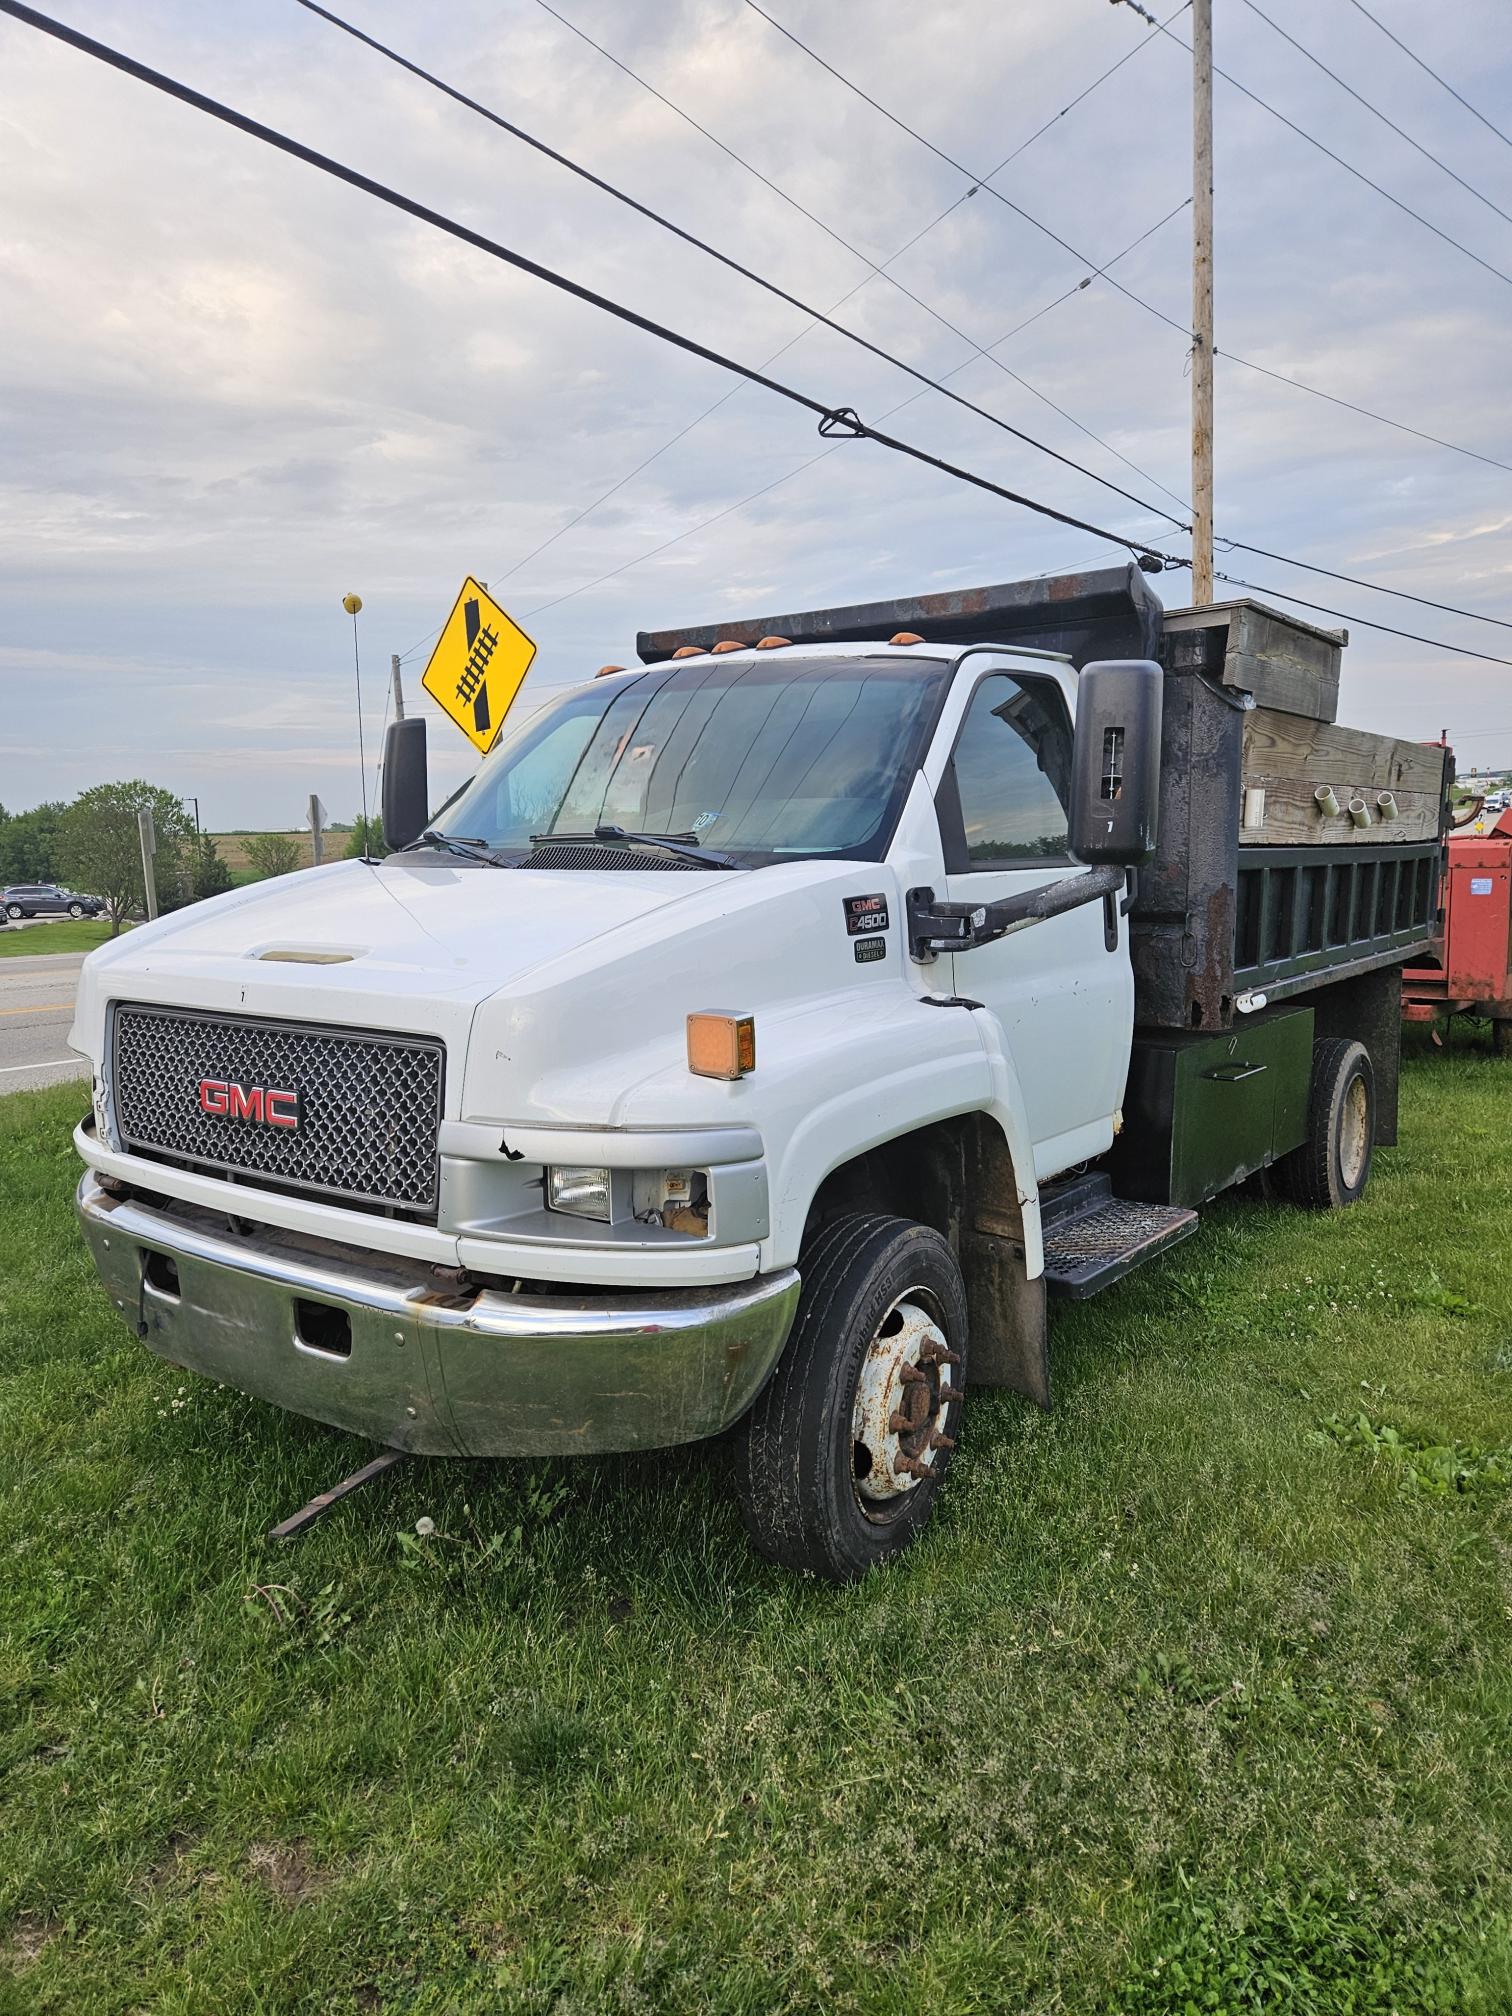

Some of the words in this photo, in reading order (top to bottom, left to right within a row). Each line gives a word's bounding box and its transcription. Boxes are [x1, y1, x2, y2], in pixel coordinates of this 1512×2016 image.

[852, 899, 881, 912] GMC
[850, 913, 887, 931] C4500
[856, 940, 884, 951] DURAMAX
[862, 951, 880, 960] DIESEL
[200, 1079, 298, 1128] GMC
[840, 1363, 856, 1412] Conti
[852, 1304, 876, 1360] Hybrid
[874, 1277, 893, 1306] HS3
